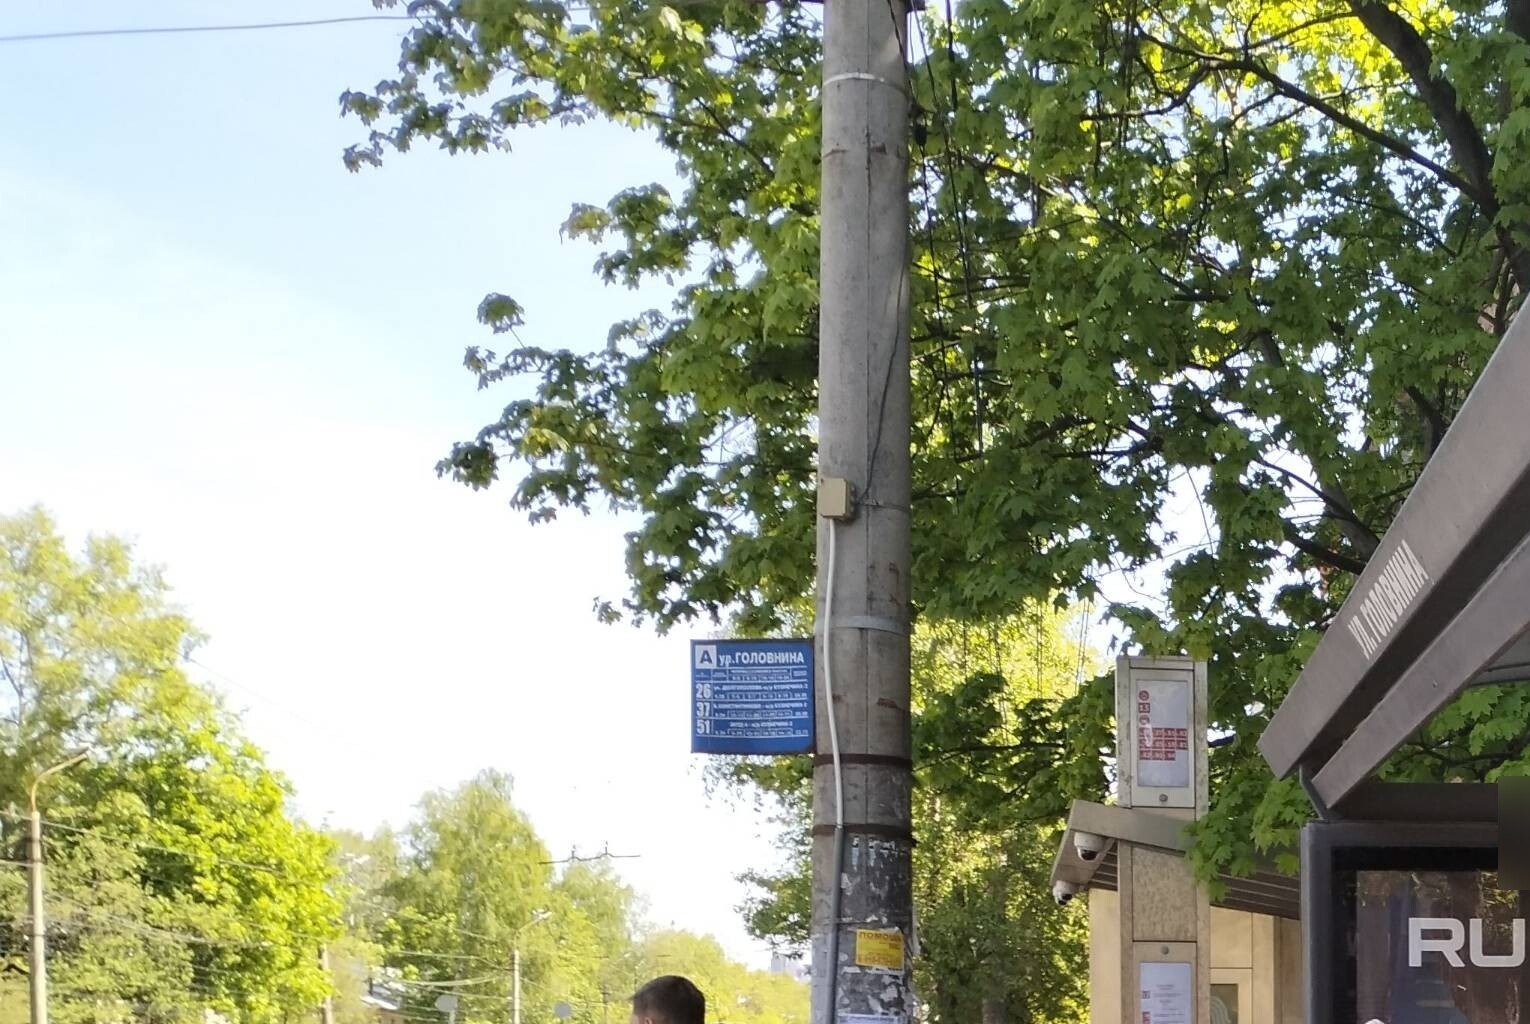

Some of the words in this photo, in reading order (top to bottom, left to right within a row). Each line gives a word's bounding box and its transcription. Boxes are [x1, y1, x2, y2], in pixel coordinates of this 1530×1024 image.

[1359, 539, 1429, 643] ГОЛОВНИНА
[695, 683, 711, 699] 26
[696, 701, 710, 717] 37
[696, 719, 710, 735] 51
